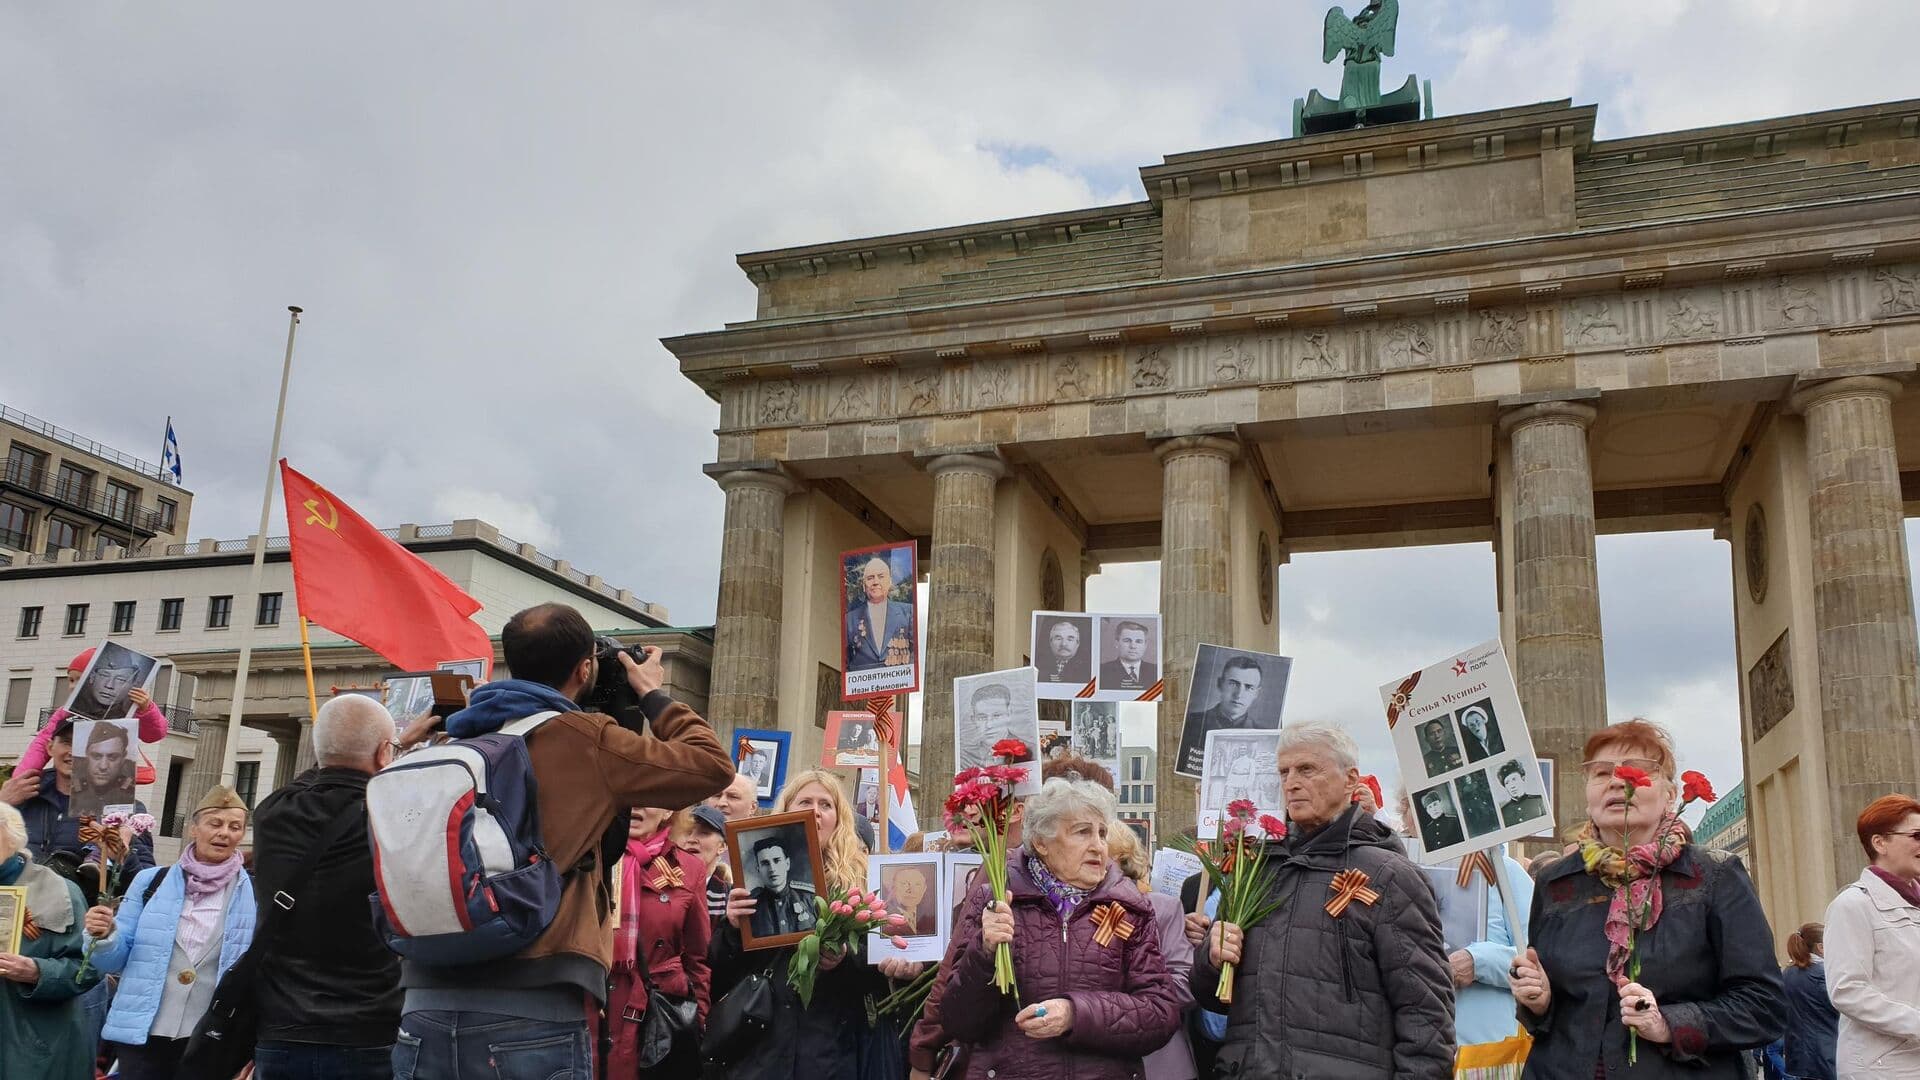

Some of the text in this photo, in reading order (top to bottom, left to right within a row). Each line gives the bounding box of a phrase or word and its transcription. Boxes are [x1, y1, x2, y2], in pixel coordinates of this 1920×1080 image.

[848, 667, 911, 683] ГОЛОВЯТИНСКИЙ
[871, 682, 908, 692] Ефимович
[1408, 682, 1488, 717] Семья Мусиных
